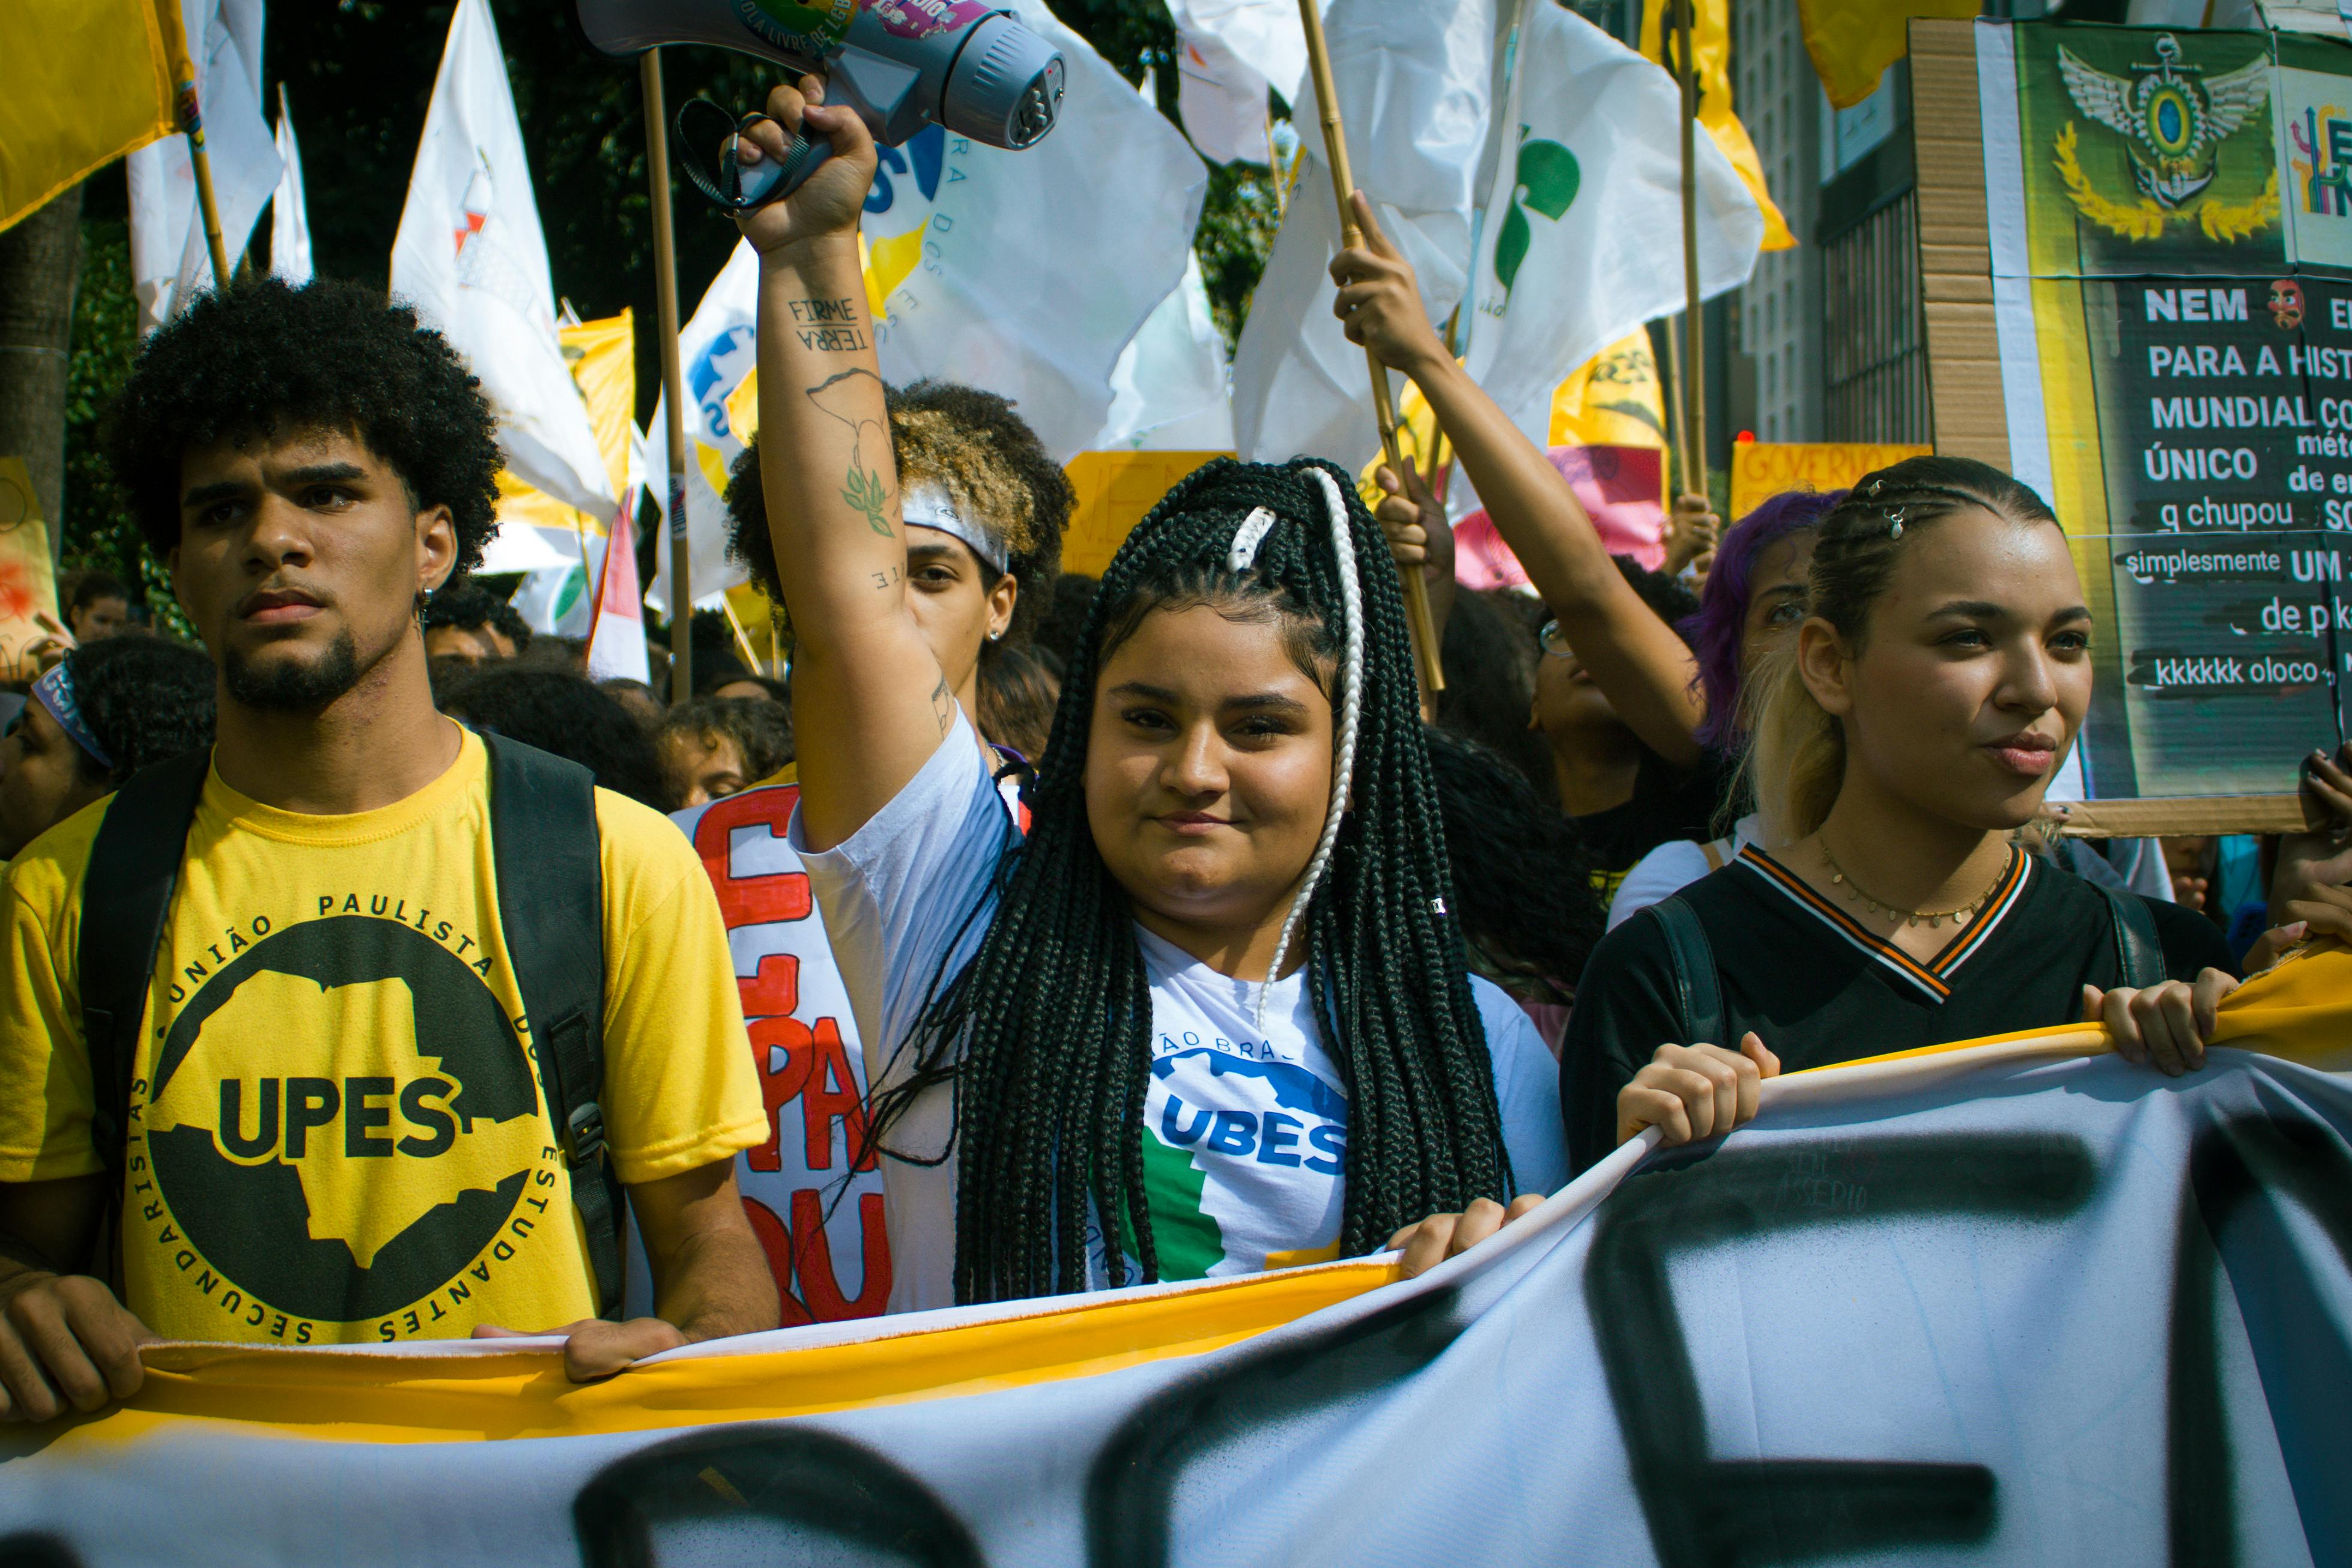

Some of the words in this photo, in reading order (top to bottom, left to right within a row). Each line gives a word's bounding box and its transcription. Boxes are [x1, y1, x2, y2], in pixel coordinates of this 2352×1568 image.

[766, 26, 808, 51] LIVRE
[788, 298, 858, 321] FIRME
[2144, 288, 2248, 322] NEM
[2330, 297, 2352, 330] E
[796, 328, 868, 351] TERRA
[2148, 345, 2247, 377] PARA
[2255, 345, 2282, 376] A
[2289, 345, 2352, 380] HIST
[2150, 395, 2317, 430] MUNDIAL
[2144, 441, 2258, 481] ÚNICO
[2297, 430, 2352, 459] mét
[2287, 465, 2325, 492] de
[2331, 472, 2352, 494] e
[2160, 504, 2181, 532] q
[2186, 495, 2293, 532] chupou
[2126, 548, 2282, 578] simplesmente
[2290, 550, 2342, 582] UM
[2260, 596, 2301, 631] de
[2155, 657, 2244, 686] kkkkkk
[2249, 656, 2318, 683] oloco
[318, 892, 495, 977] PAULISTA
[168, 914, 272, 1005] UNIÃO
[742, 1016, 880, 1173] PA
[219, 1077, 455, 1158] UPES
[1161, 1094, 1347, 1176] UBES
[127, 1077, 314, 1345] SECUNDARISTAS
[379, 1145, 558, 1343] ESTUDANTES
